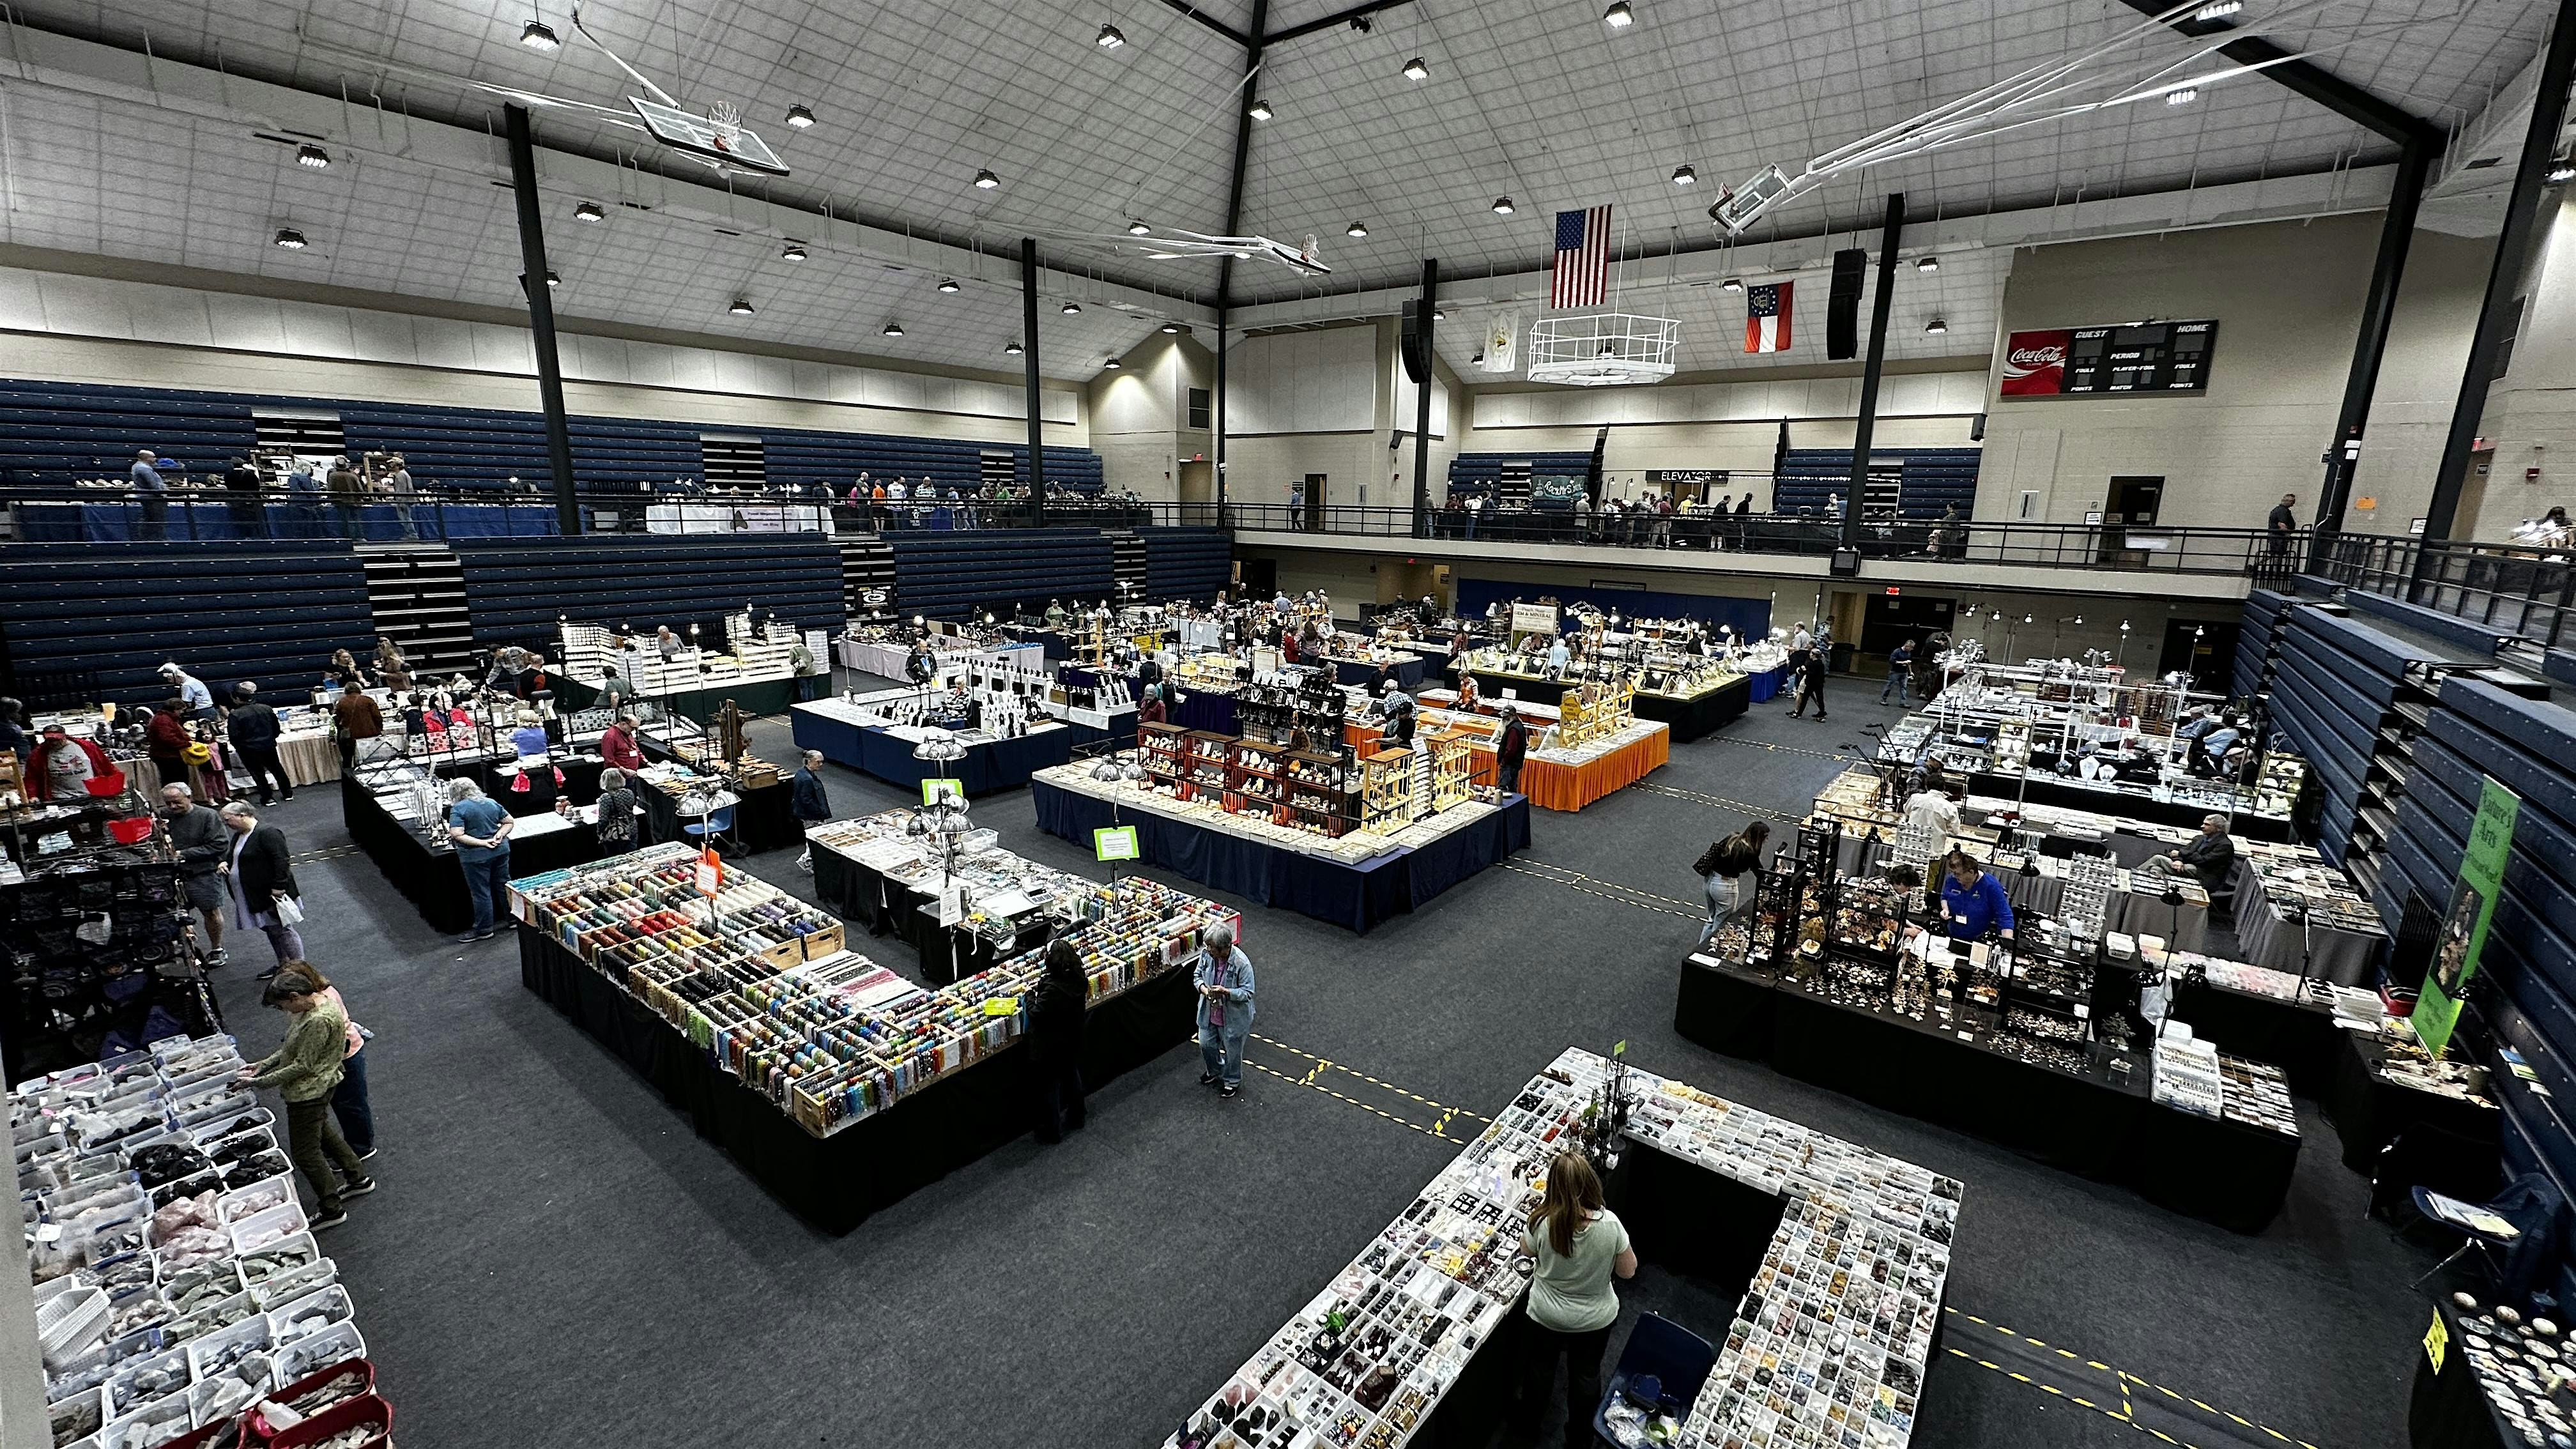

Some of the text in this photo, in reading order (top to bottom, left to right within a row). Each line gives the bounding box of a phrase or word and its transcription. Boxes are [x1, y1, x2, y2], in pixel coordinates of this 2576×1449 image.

[2177, 324, 2210, 333] HOME
[2075, 330, 2108, 339] GUEST
[2011, 345, 2066, 364] Coca-Cola
